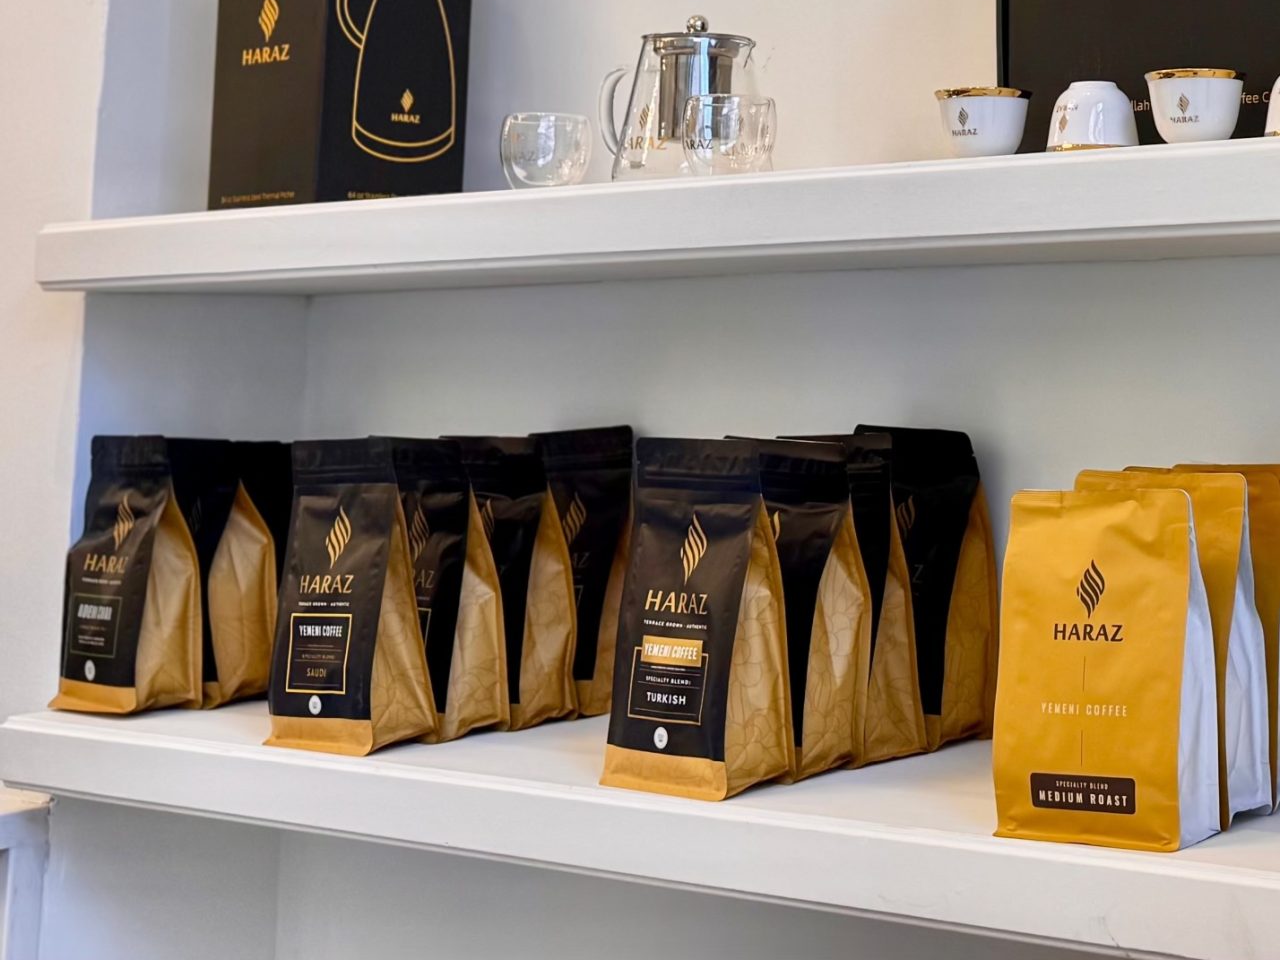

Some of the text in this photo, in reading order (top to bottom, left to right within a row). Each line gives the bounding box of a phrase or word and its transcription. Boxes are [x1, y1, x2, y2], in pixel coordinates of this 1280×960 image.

[242, 43, 290, 66] HARAZ
[391, 112, 421, 124] HARAZ
[299, 574, 354, 594] HARAZ
[644, 589, 708, 615] HARAZ
[299, 624, 343, 638] YEMENI COFFEE
[1053, 623, 1124, 642] HARAZ
[644, 643, 698, 660] YEMENI COFFEE
[645, 675, 670, 683] SPECIALTY
[646, 691, 687, 706] TURKISH
[1041, 702, 1128, 718] YEMENI COFFEE
[1055, 780, 1109, 791] SPECIALTY BLEND
[1039, 790, 1128, 807] MEDIUM ROAST
